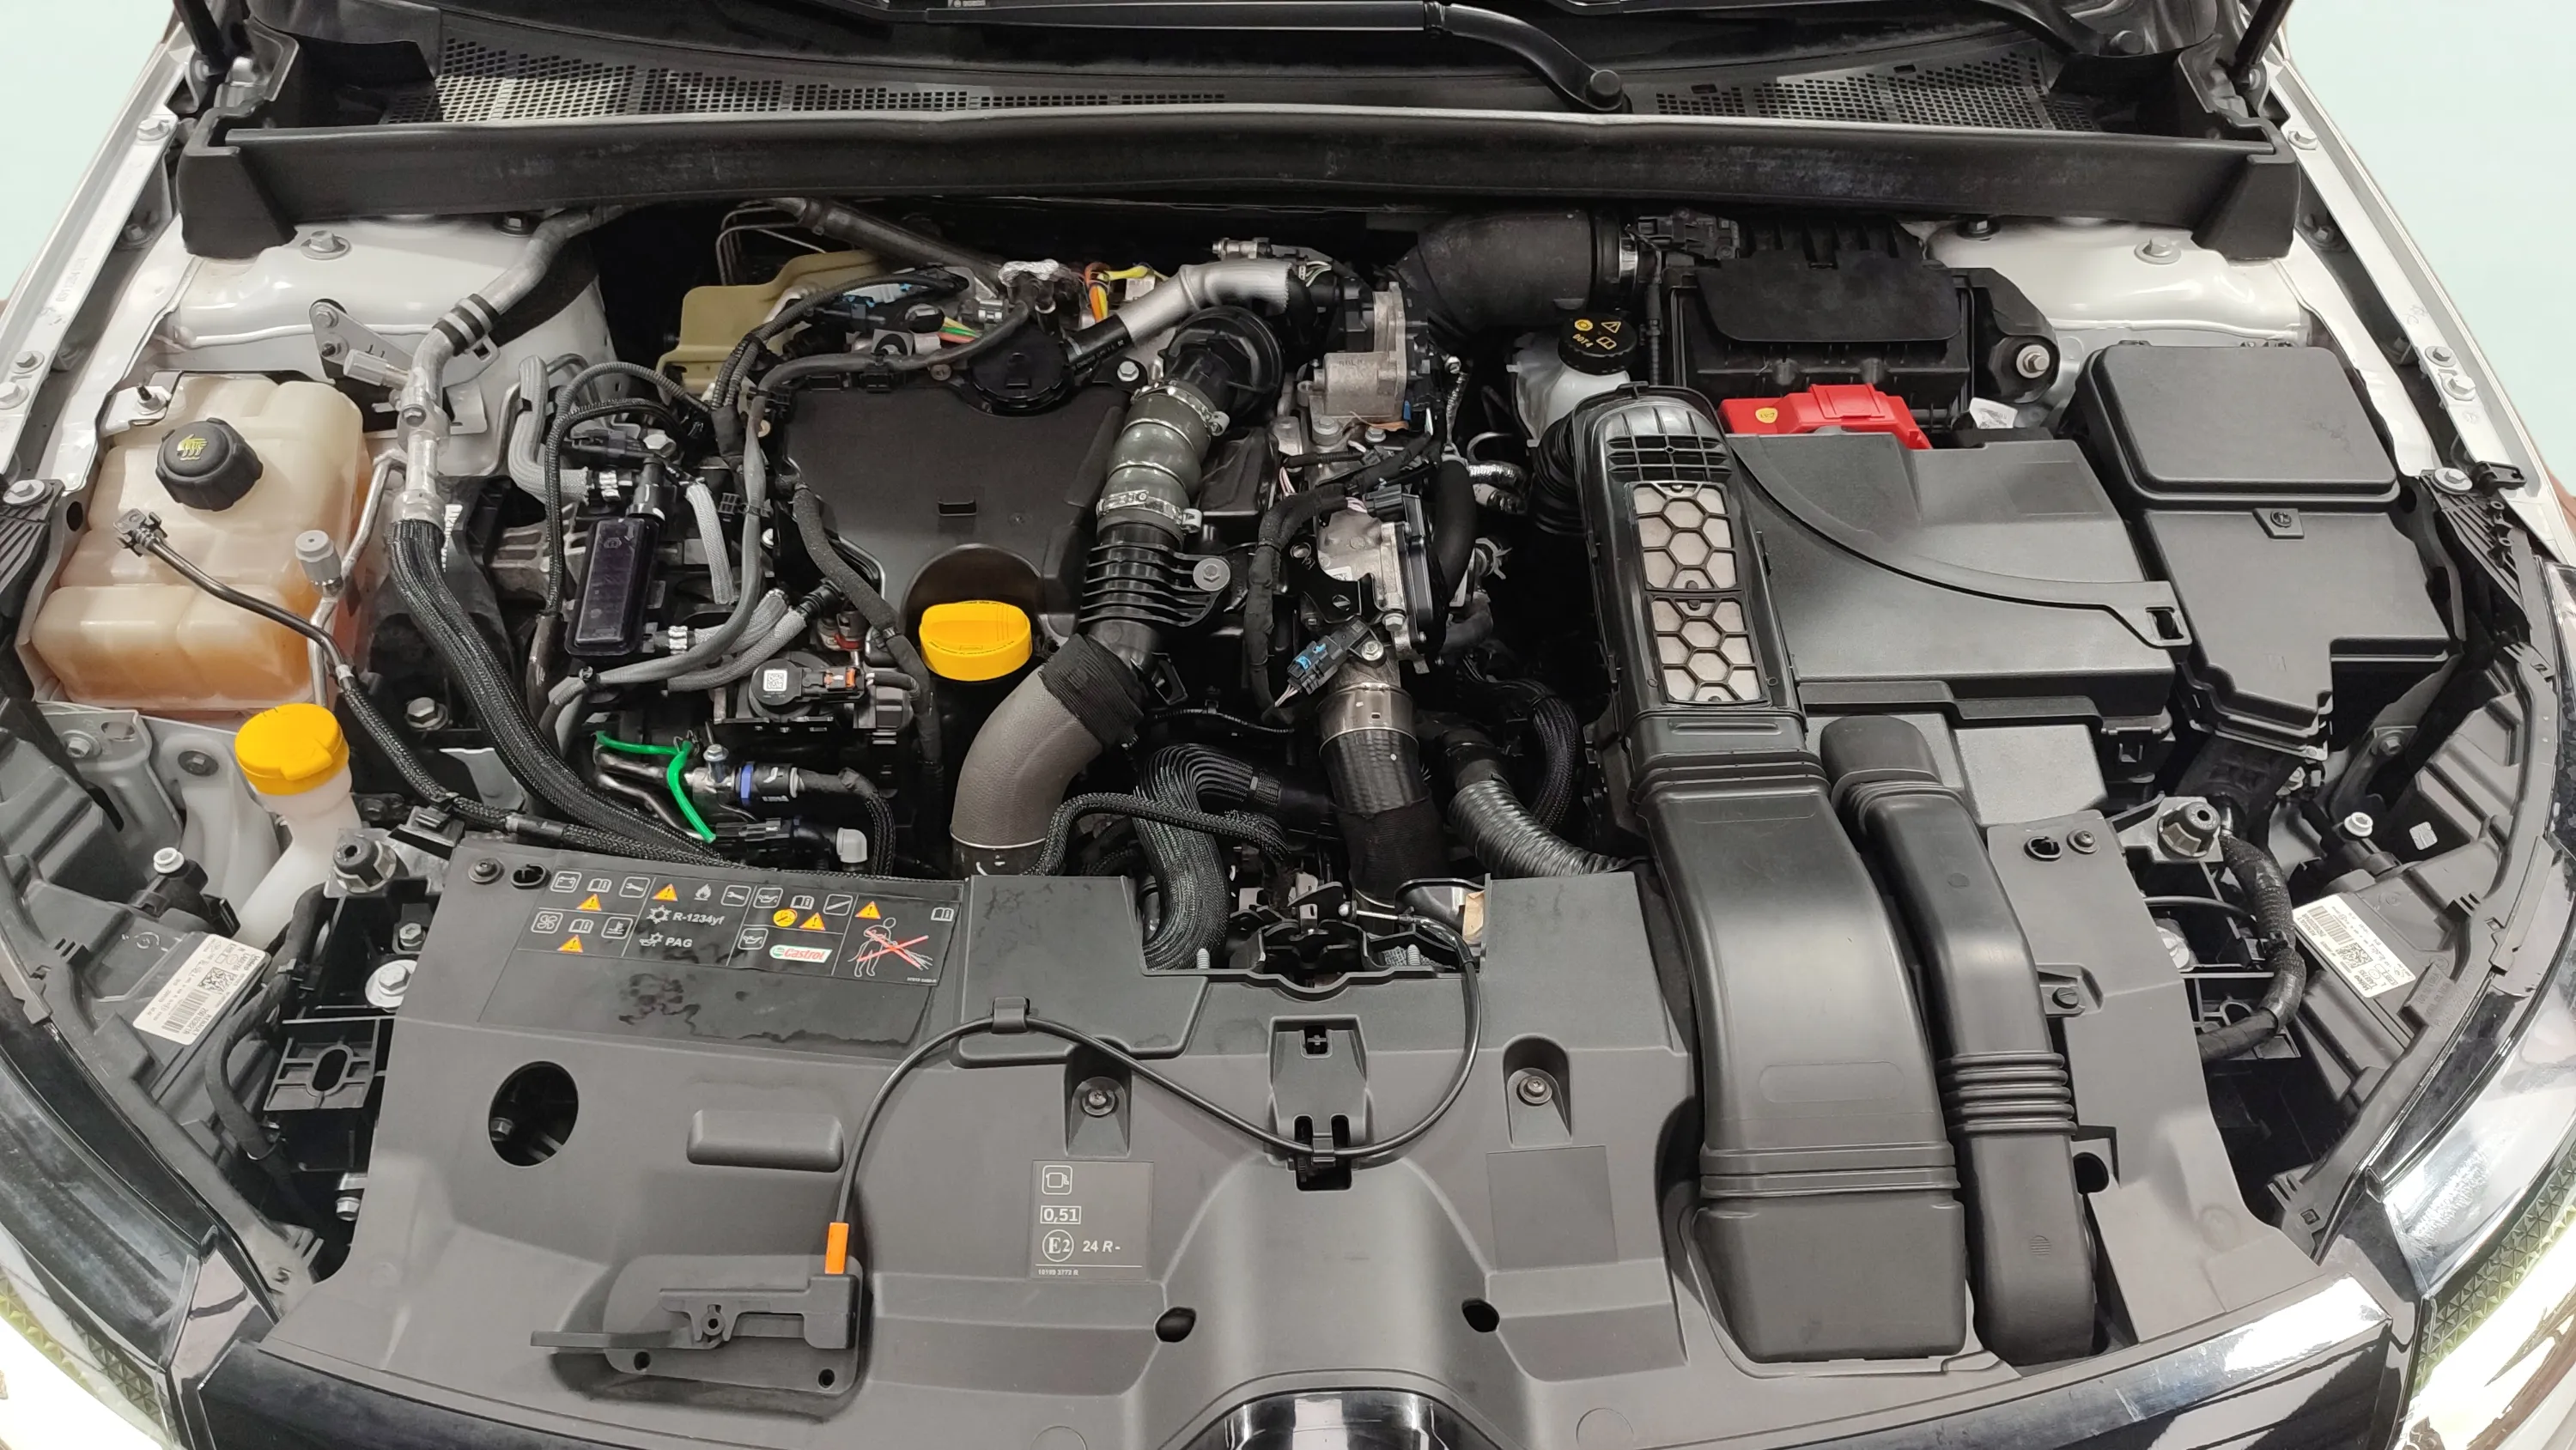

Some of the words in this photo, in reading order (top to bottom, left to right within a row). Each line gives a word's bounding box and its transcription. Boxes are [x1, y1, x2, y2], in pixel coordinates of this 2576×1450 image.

[672, 912, 726, 926] R-1234yf
[665, 937, 693, 948] PAG
[782, 947, 826, 961] Castrol
[1043, 1208, 1078, 1223] 0,51
[1082, 1241, 1099, 1253] 24
